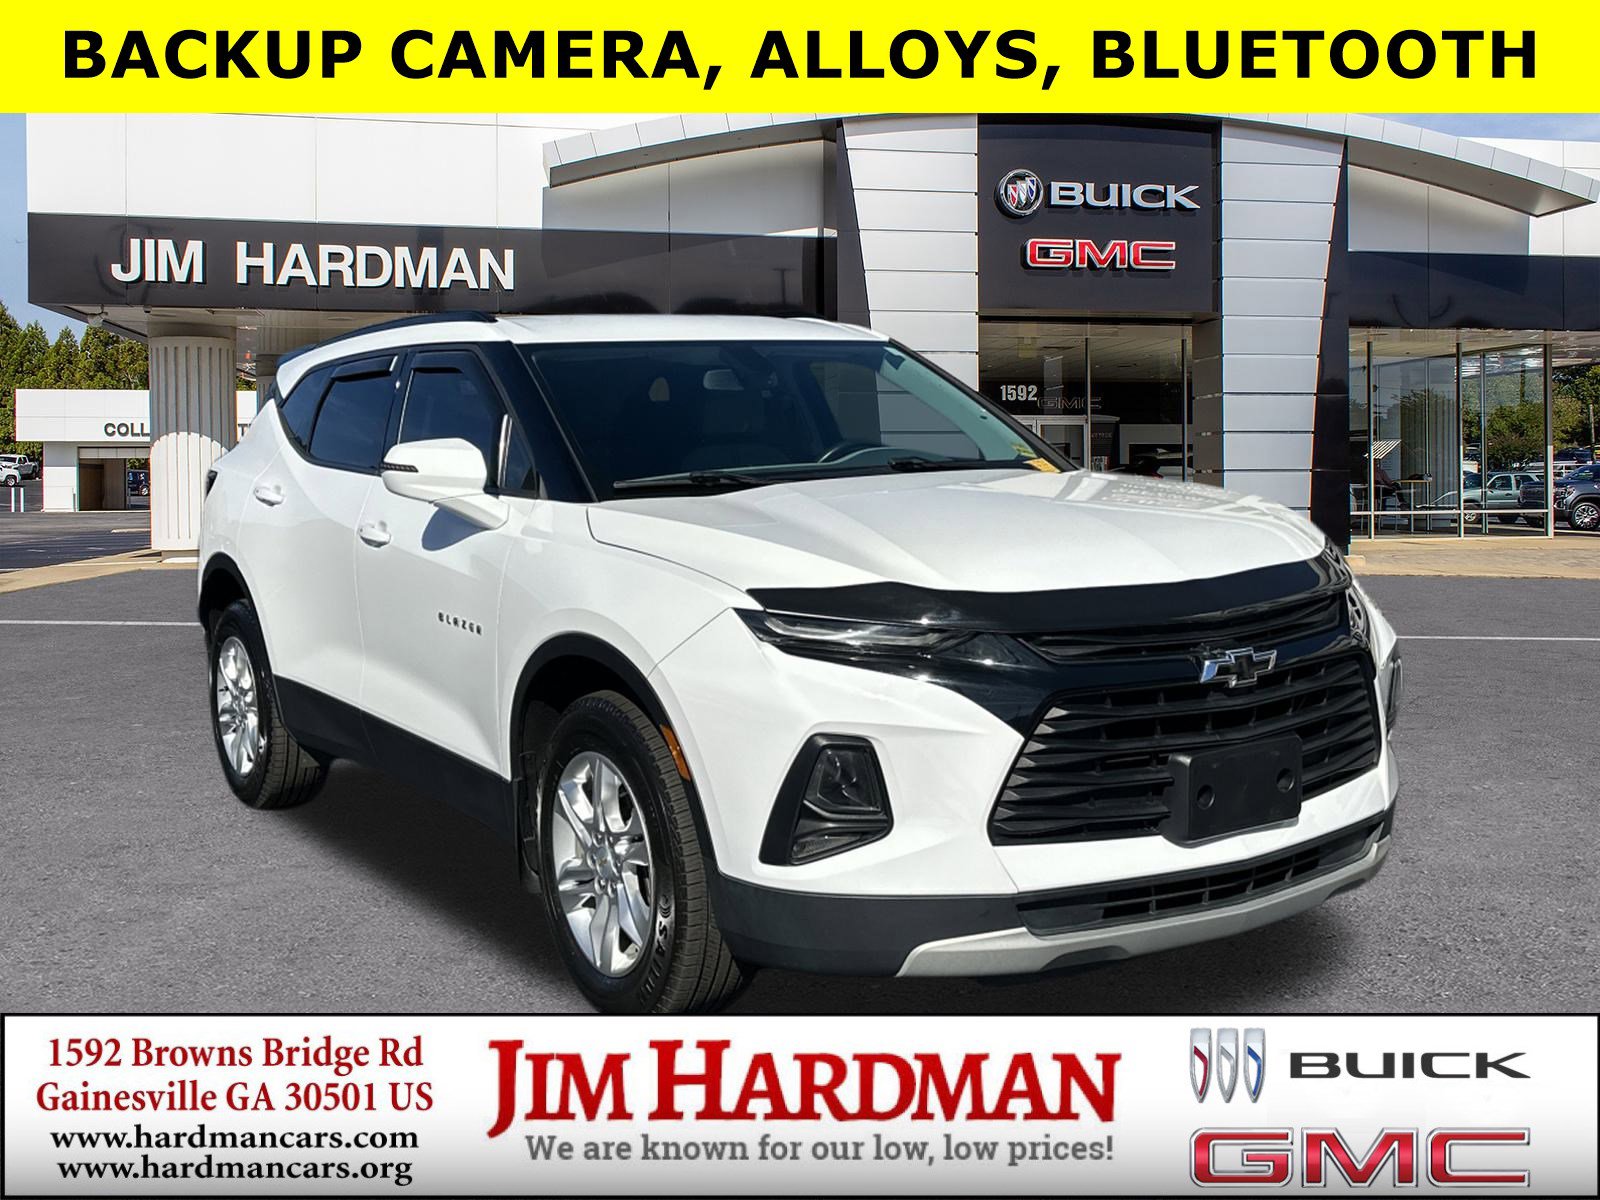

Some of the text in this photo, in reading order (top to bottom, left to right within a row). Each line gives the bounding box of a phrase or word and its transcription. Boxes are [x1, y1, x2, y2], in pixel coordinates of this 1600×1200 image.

[1050, 180, 1200, 209] BUICK
[111, 238, 515, 290] JIM HARDMAN
[1026, 238, 1176, 269] GMC
[1000, 384, 1038, 401] 1592
[438, 611, 482, 636] BLAZER
